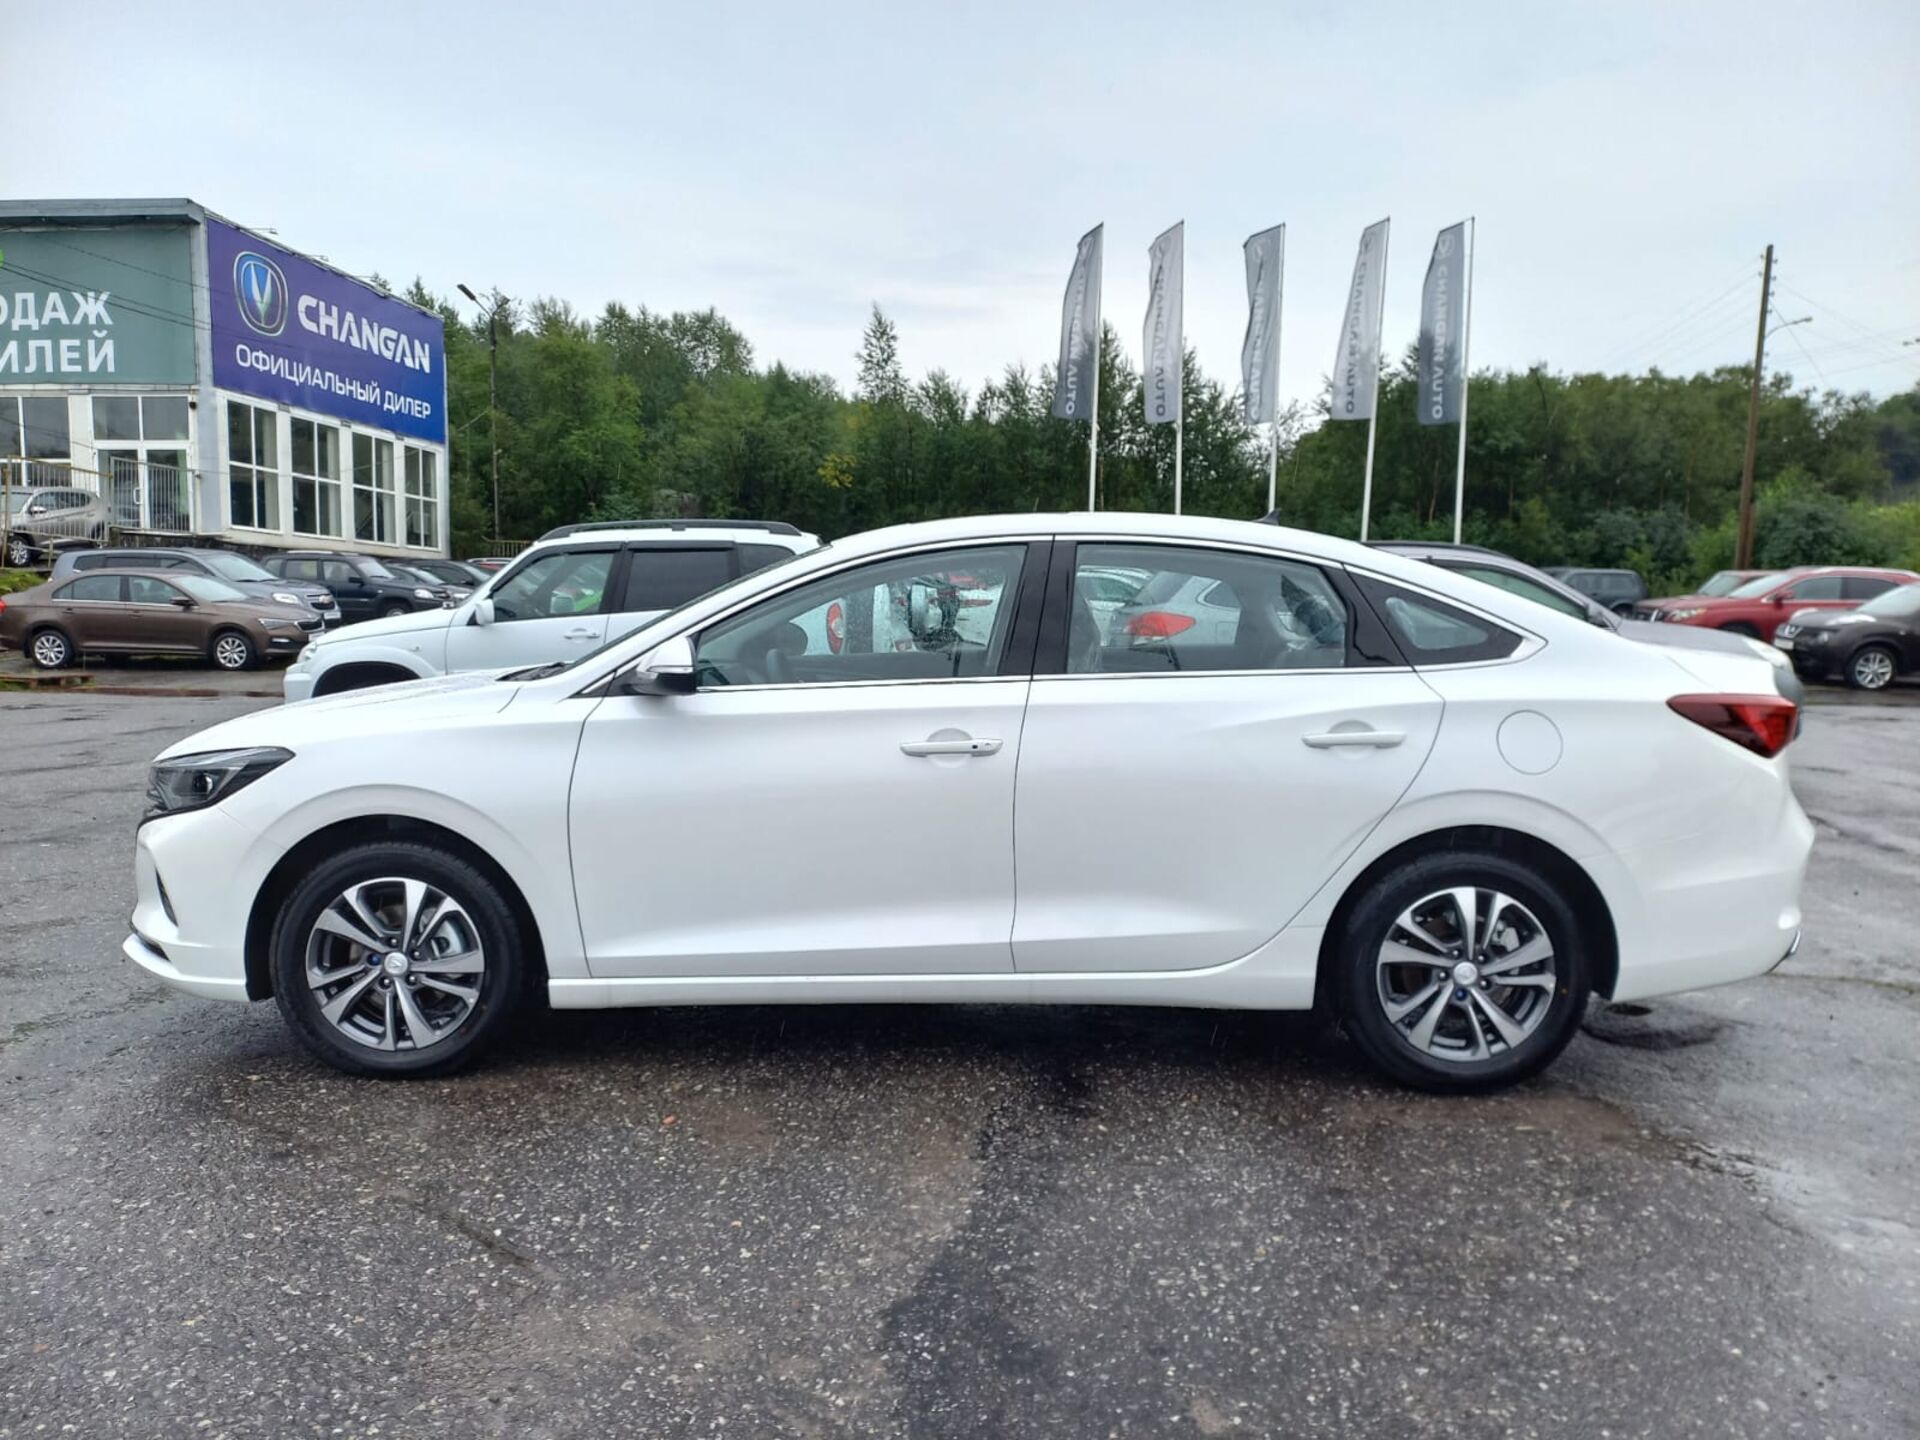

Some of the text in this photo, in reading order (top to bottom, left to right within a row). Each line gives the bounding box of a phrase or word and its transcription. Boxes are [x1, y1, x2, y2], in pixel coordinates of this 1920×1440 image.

[0, 292, 114, 331] ДАЖ
[297, 294, 431, 374] CHANGAN
[1345, 262, 1367, 414] CHANGAN AUTO
[1431, 266, 1449, 420] CHANGAN AUTO
[0, 329, 115, 374] ИЛЕЙ
[235, 344, 431, 420] ОФИЦИАЛЬНЫЙ ДИЛЕР
[1065, 365, 1079, 416] AUTO
[1154, 366, 1167, 417] AUTO
